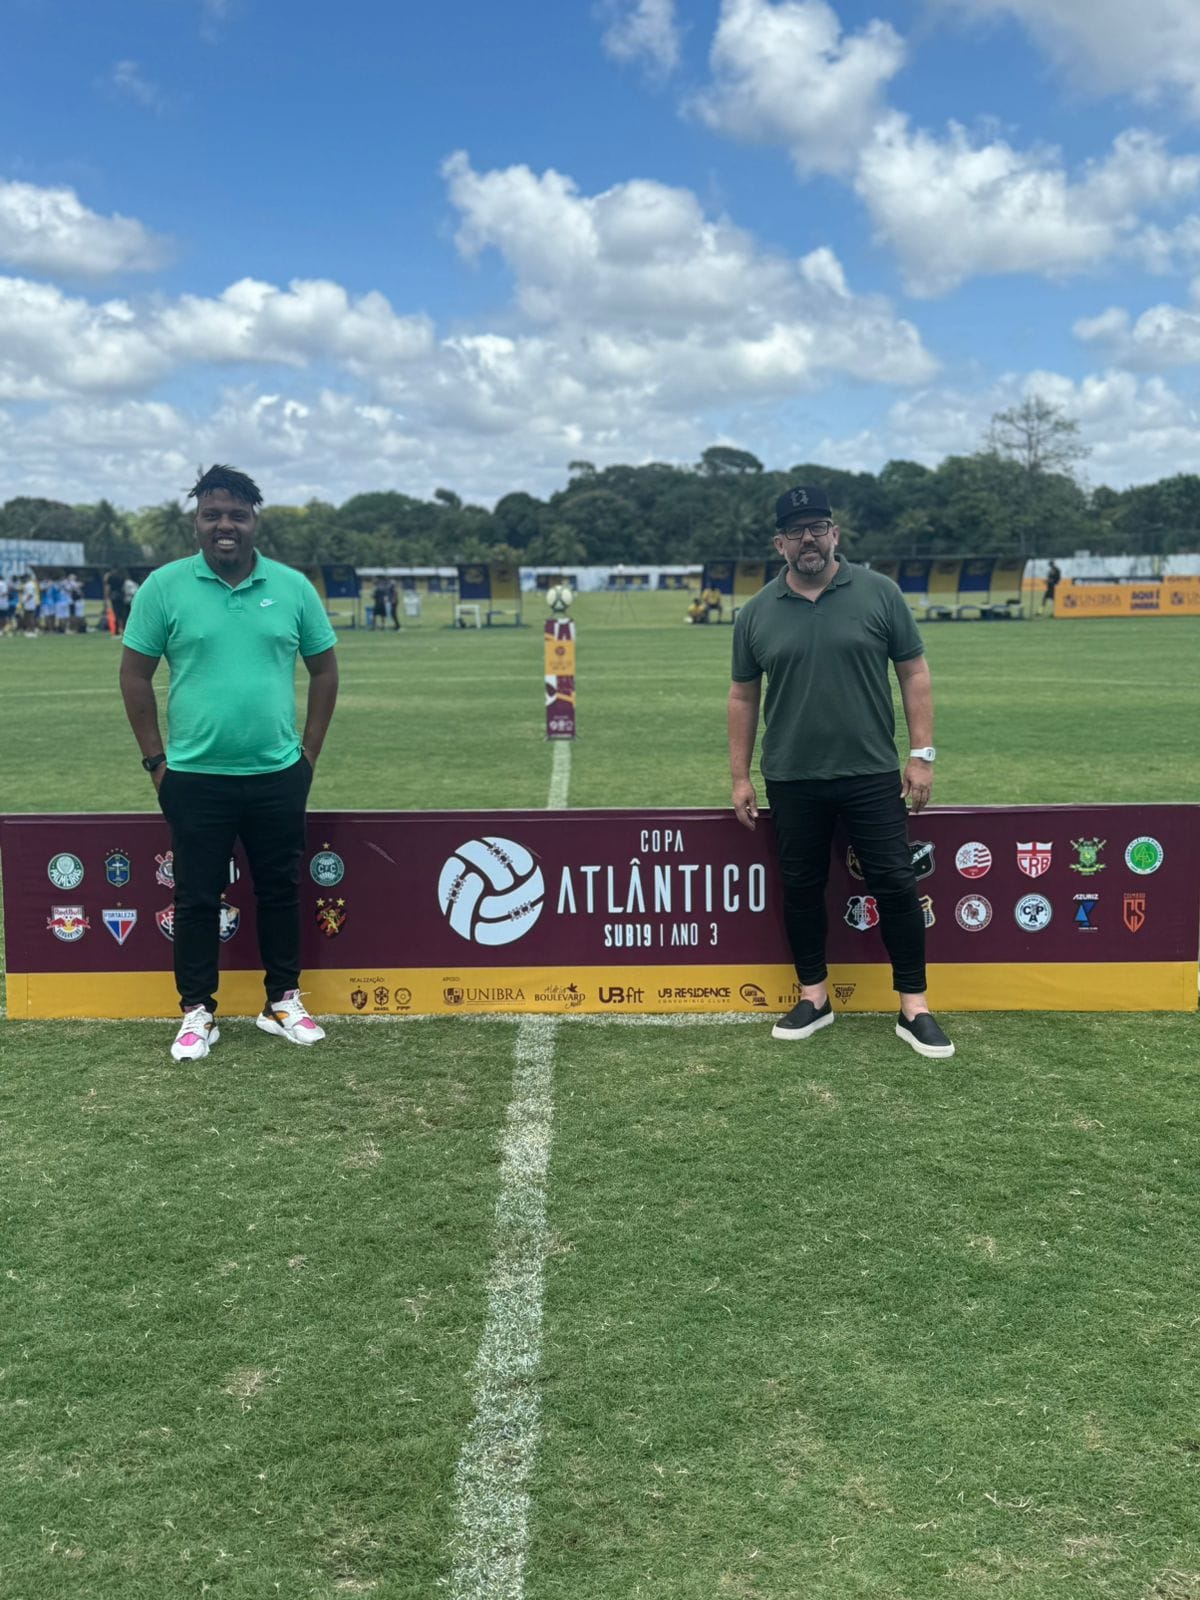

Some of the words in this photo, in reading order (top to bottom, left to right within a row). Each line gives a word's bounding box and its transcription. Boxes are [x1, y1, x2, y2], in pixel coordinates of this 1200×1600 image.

[640, 829, 684, 853] COPA
[1018, 857, 1050, 875] CRB
[50, 868, 82, 888] PALMEIRAS
[556, 858, 766, 915] ATLÂNTICO
[104, 911, 135, 919] FORTALEZA
[604, 923, 651, 948] SUB19
[671, 922, 699, 947] ANO
[709, 922, 718, 946] 3
[466, 987, 526, 1001] UNIBRA
[534, 993, 586, 1001] BOULEVARD
[658, 988, 673, 998] UB
[674, 987, 731, 998] RESIDENCE
